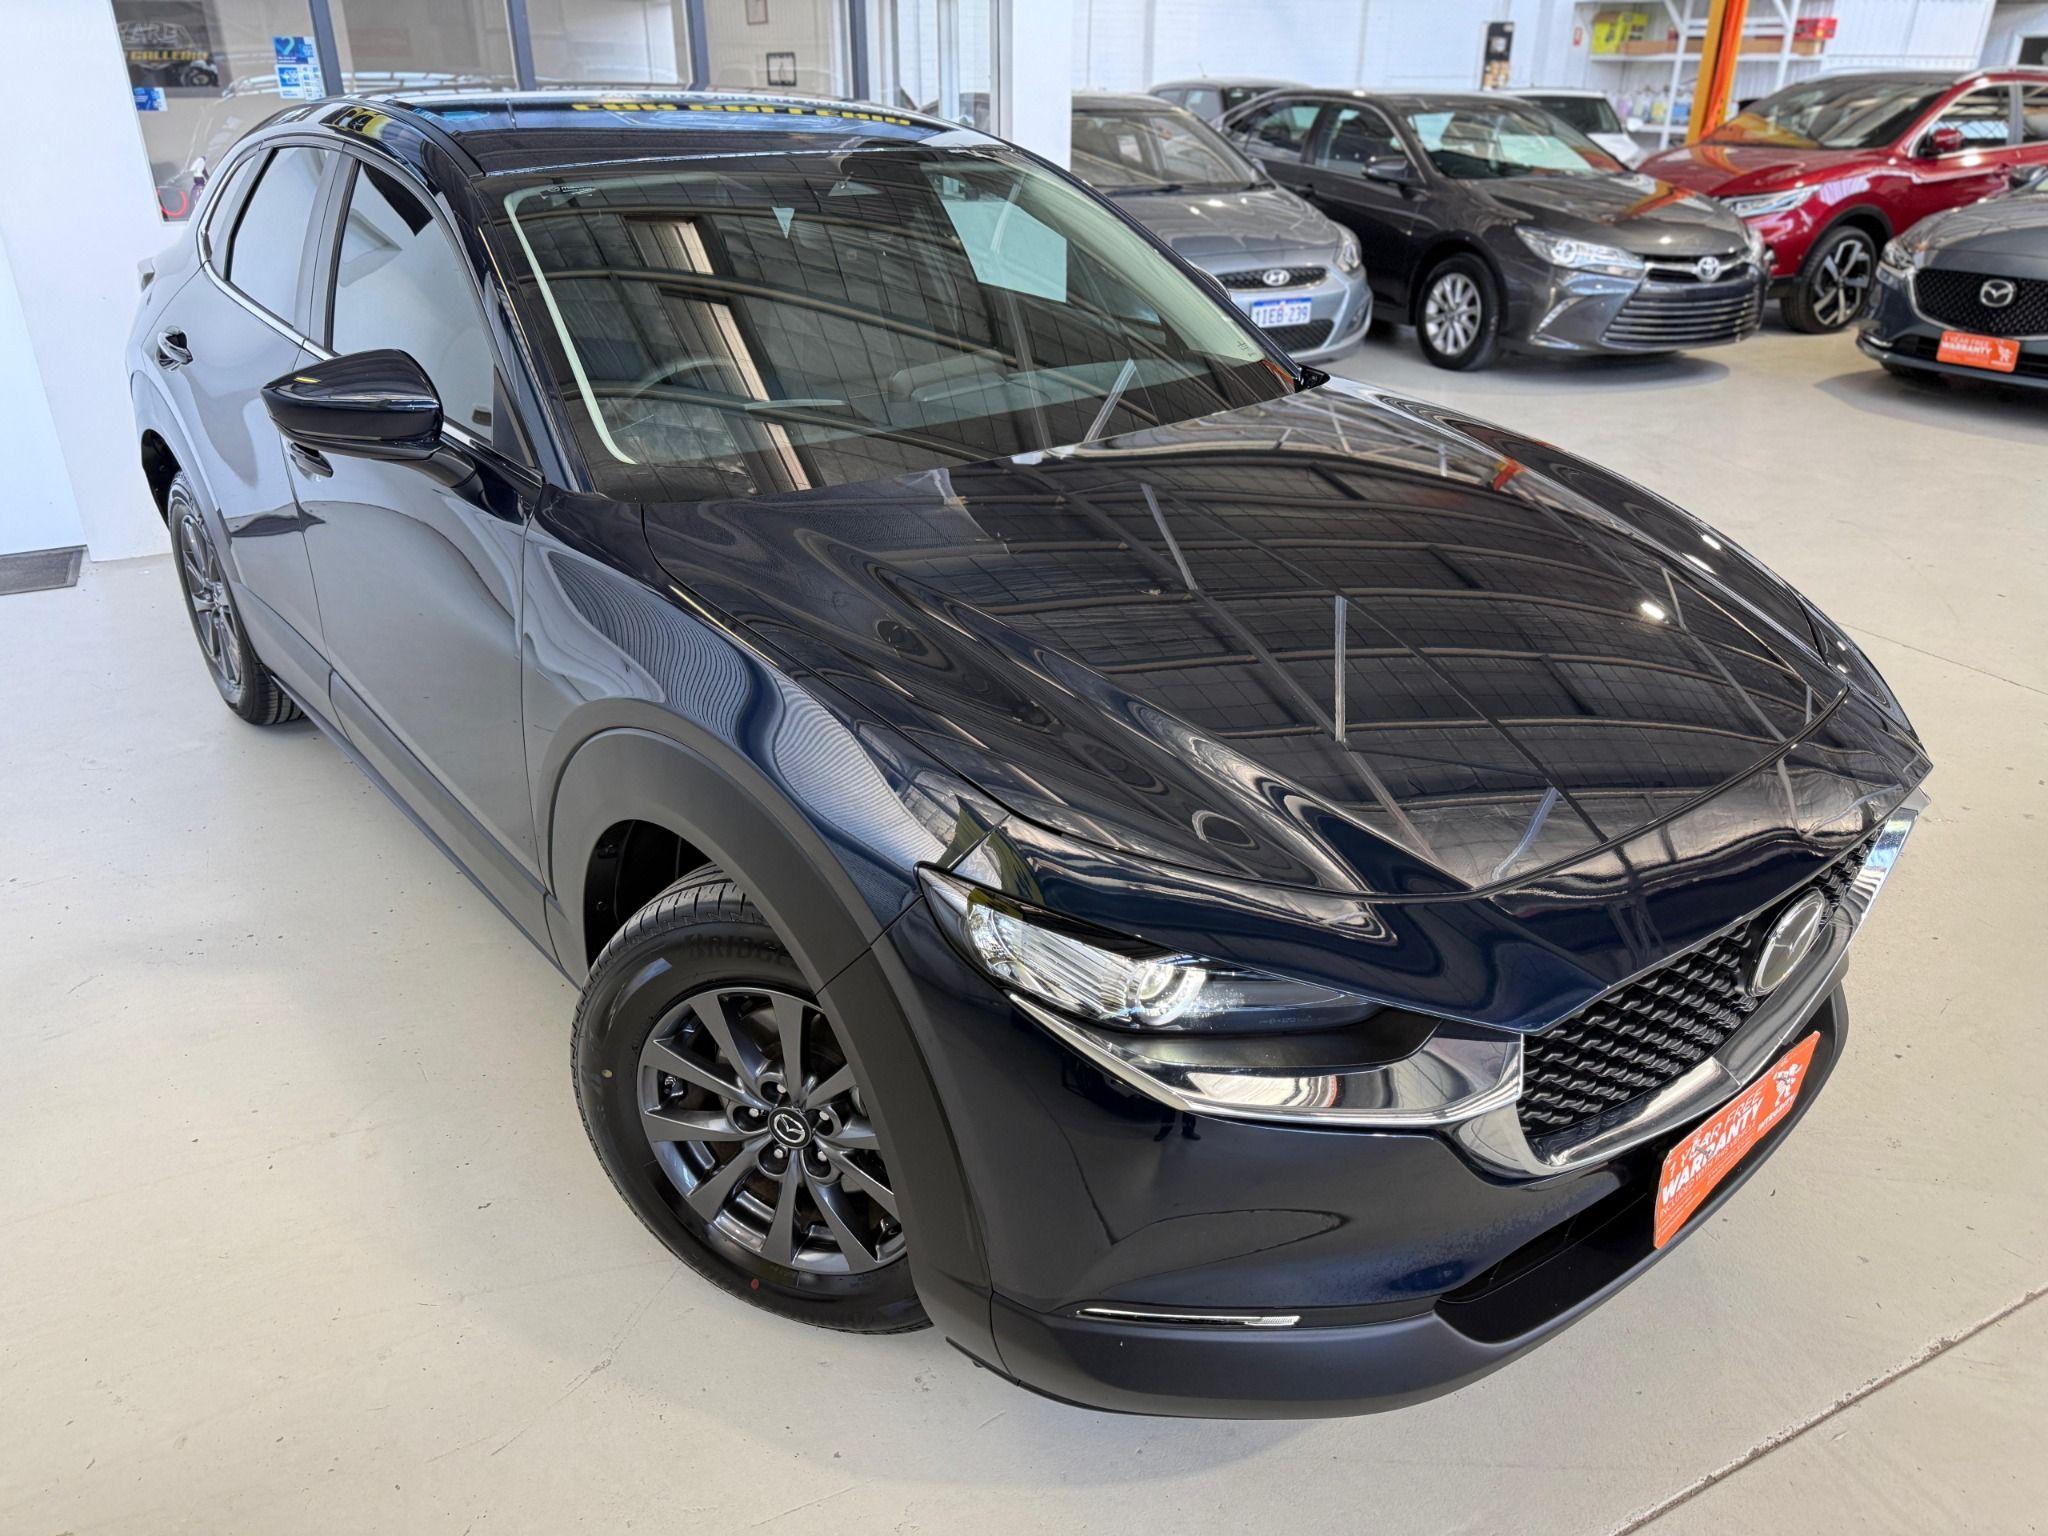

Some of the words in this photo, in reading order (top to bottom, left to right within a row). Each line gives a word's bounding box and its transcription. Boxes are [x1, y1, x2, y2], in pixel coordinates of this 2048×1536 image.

[1661, 1096, 1764, 1206] WARRANTY
[1681, 1121, 1723, 1168] YEAR
[1724, 1089, 1763, 1131] FREE
